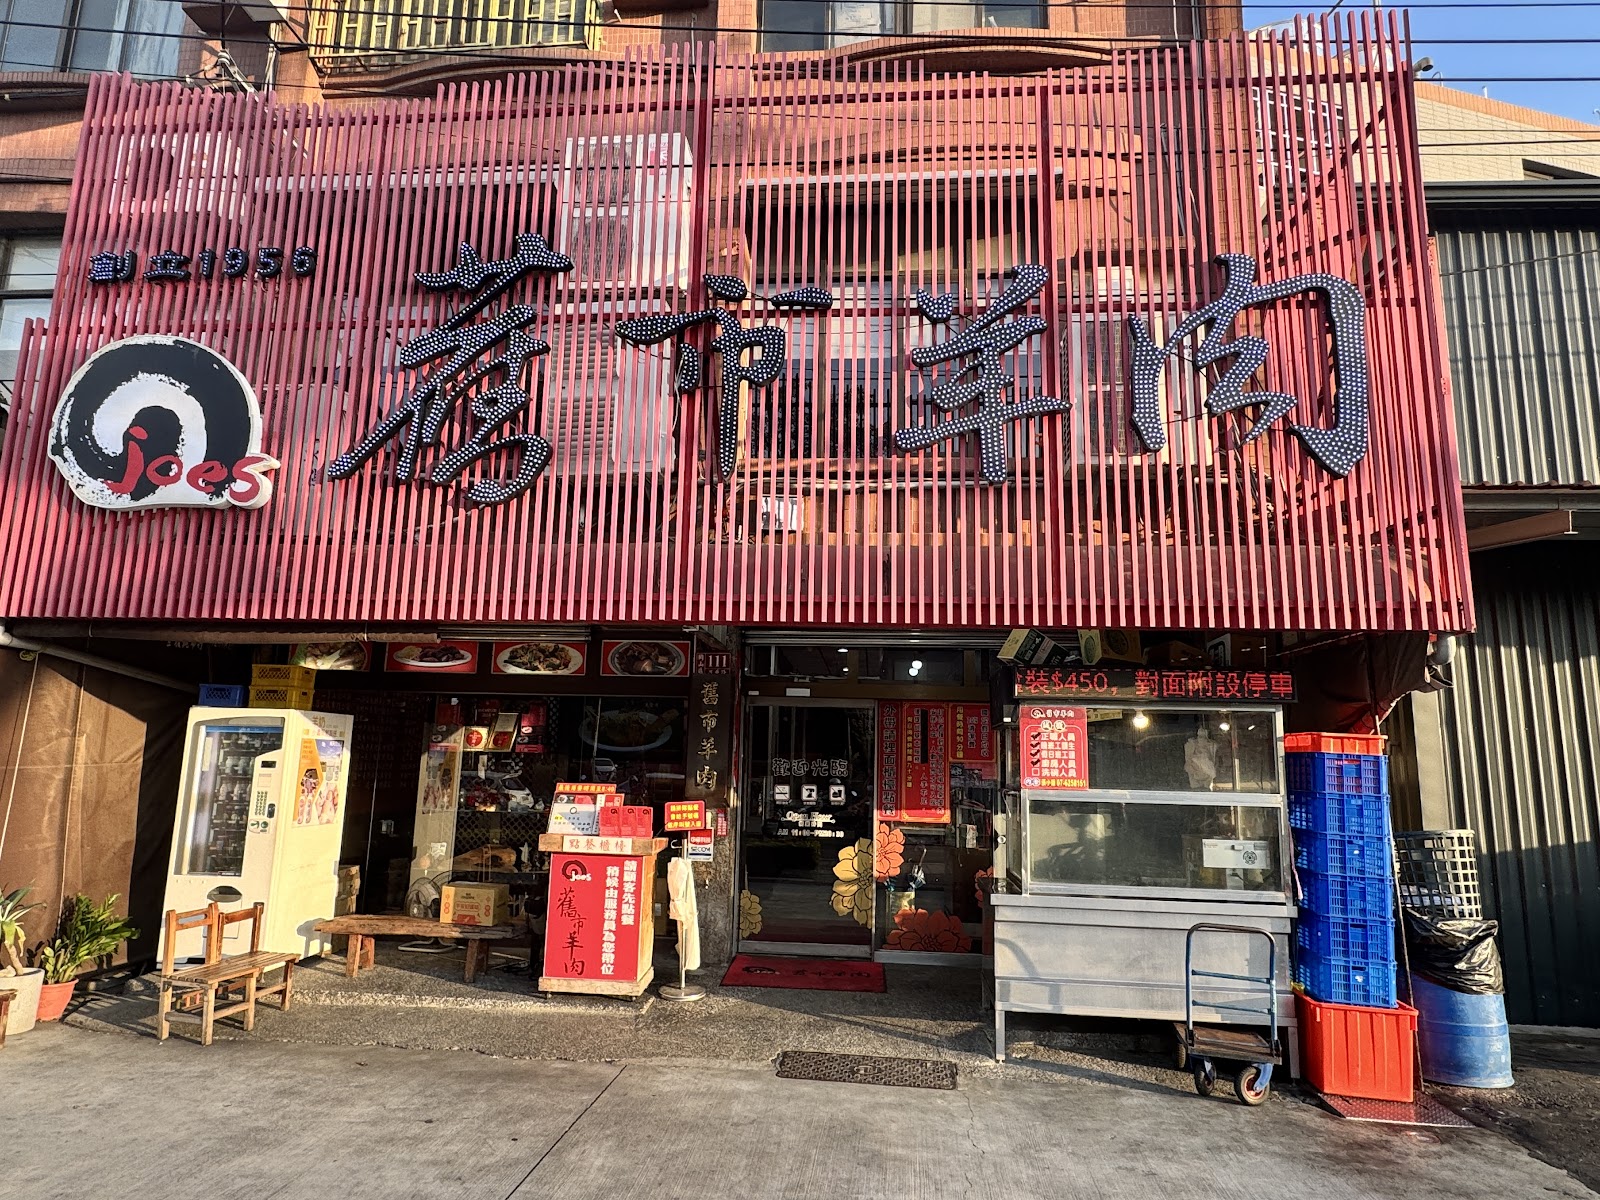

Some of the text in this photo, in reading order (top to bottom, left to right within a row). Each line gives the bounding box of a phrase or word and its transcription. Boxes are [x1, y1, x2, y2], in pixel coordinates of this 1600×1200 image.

[88, 246, 317, 284] 創立1956
[708, 654, 727, 668] 111
[695, 681, 719, 792] 舊市羊肉
[772, 758, 848, 777] 歡迎光臨
[556, 886, 587, 976] 舊市羊肉
